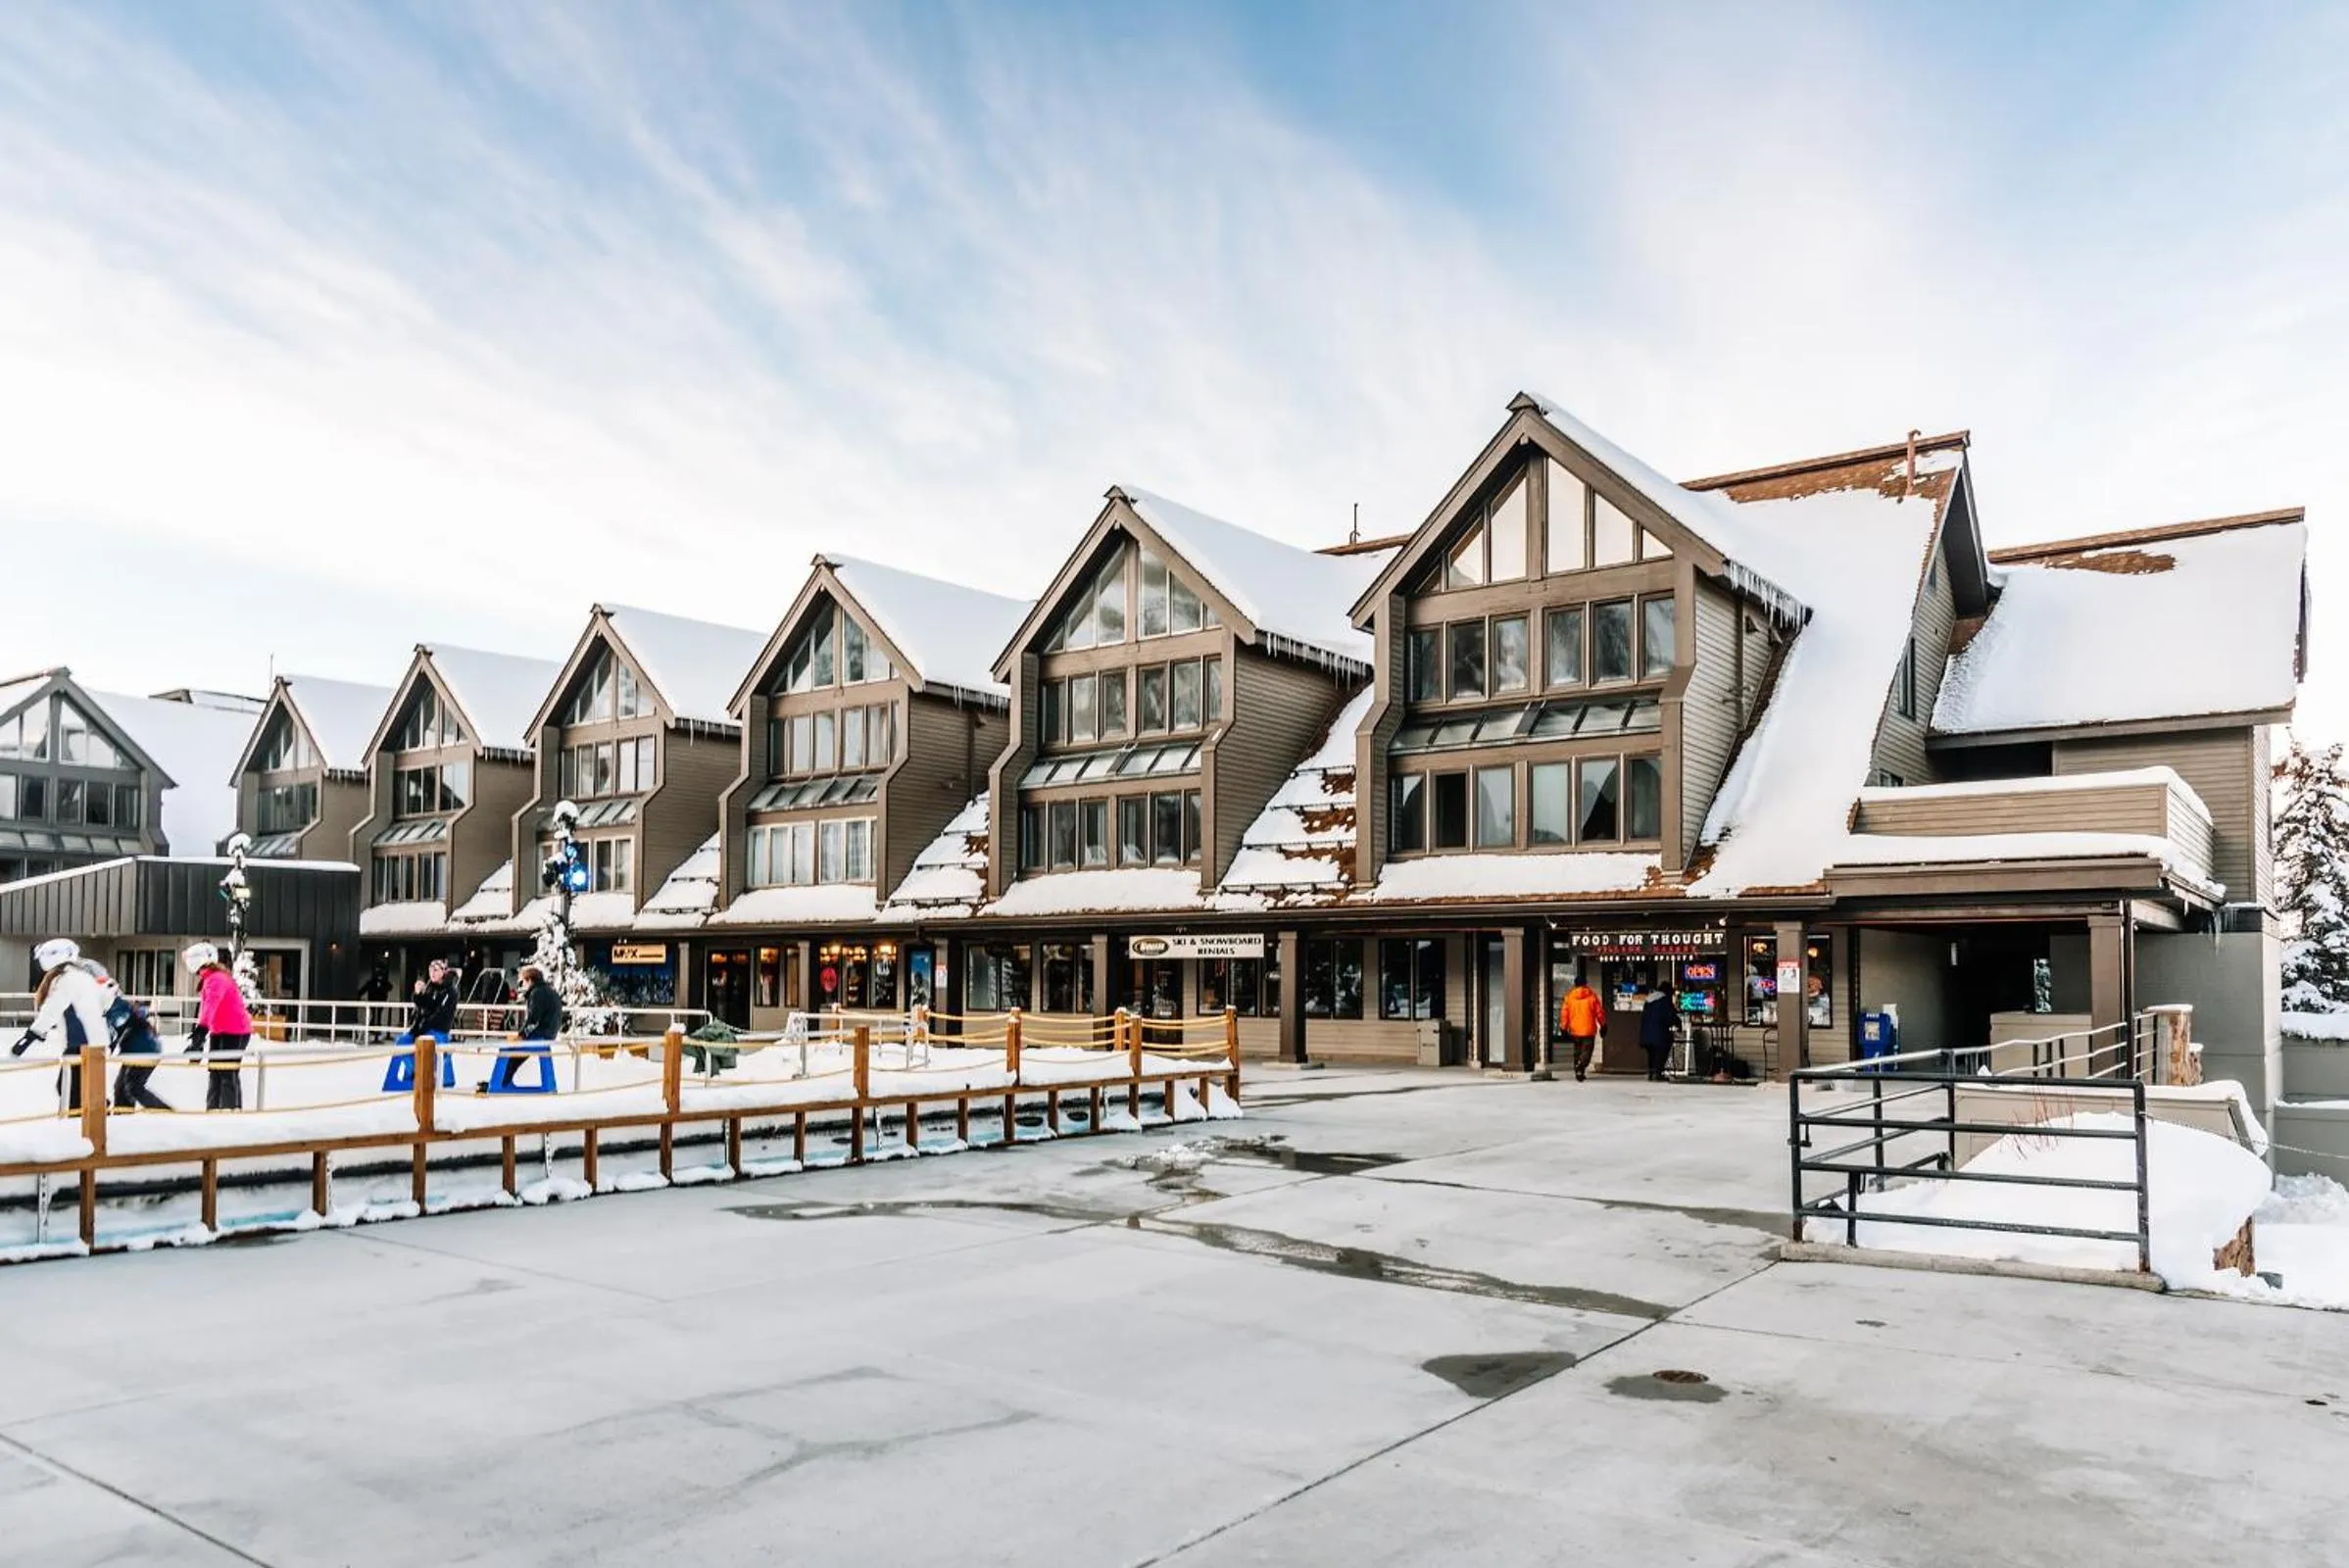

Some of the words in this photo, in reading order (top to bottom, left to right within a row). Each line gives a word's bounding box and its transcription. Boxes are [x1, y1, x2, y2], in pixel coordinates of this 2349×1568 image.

[1200, 937, 1261, 946] SNOWBOARD
[1571, 934, 1610, 947] FOOD
[1619, 934, 1643, 946] FOR
[1650, 933, 1725, 945] THOUGHT
[1197, 947, 1235, 956] RENTALS
[1687, 965, 1714, 978] OPEN
